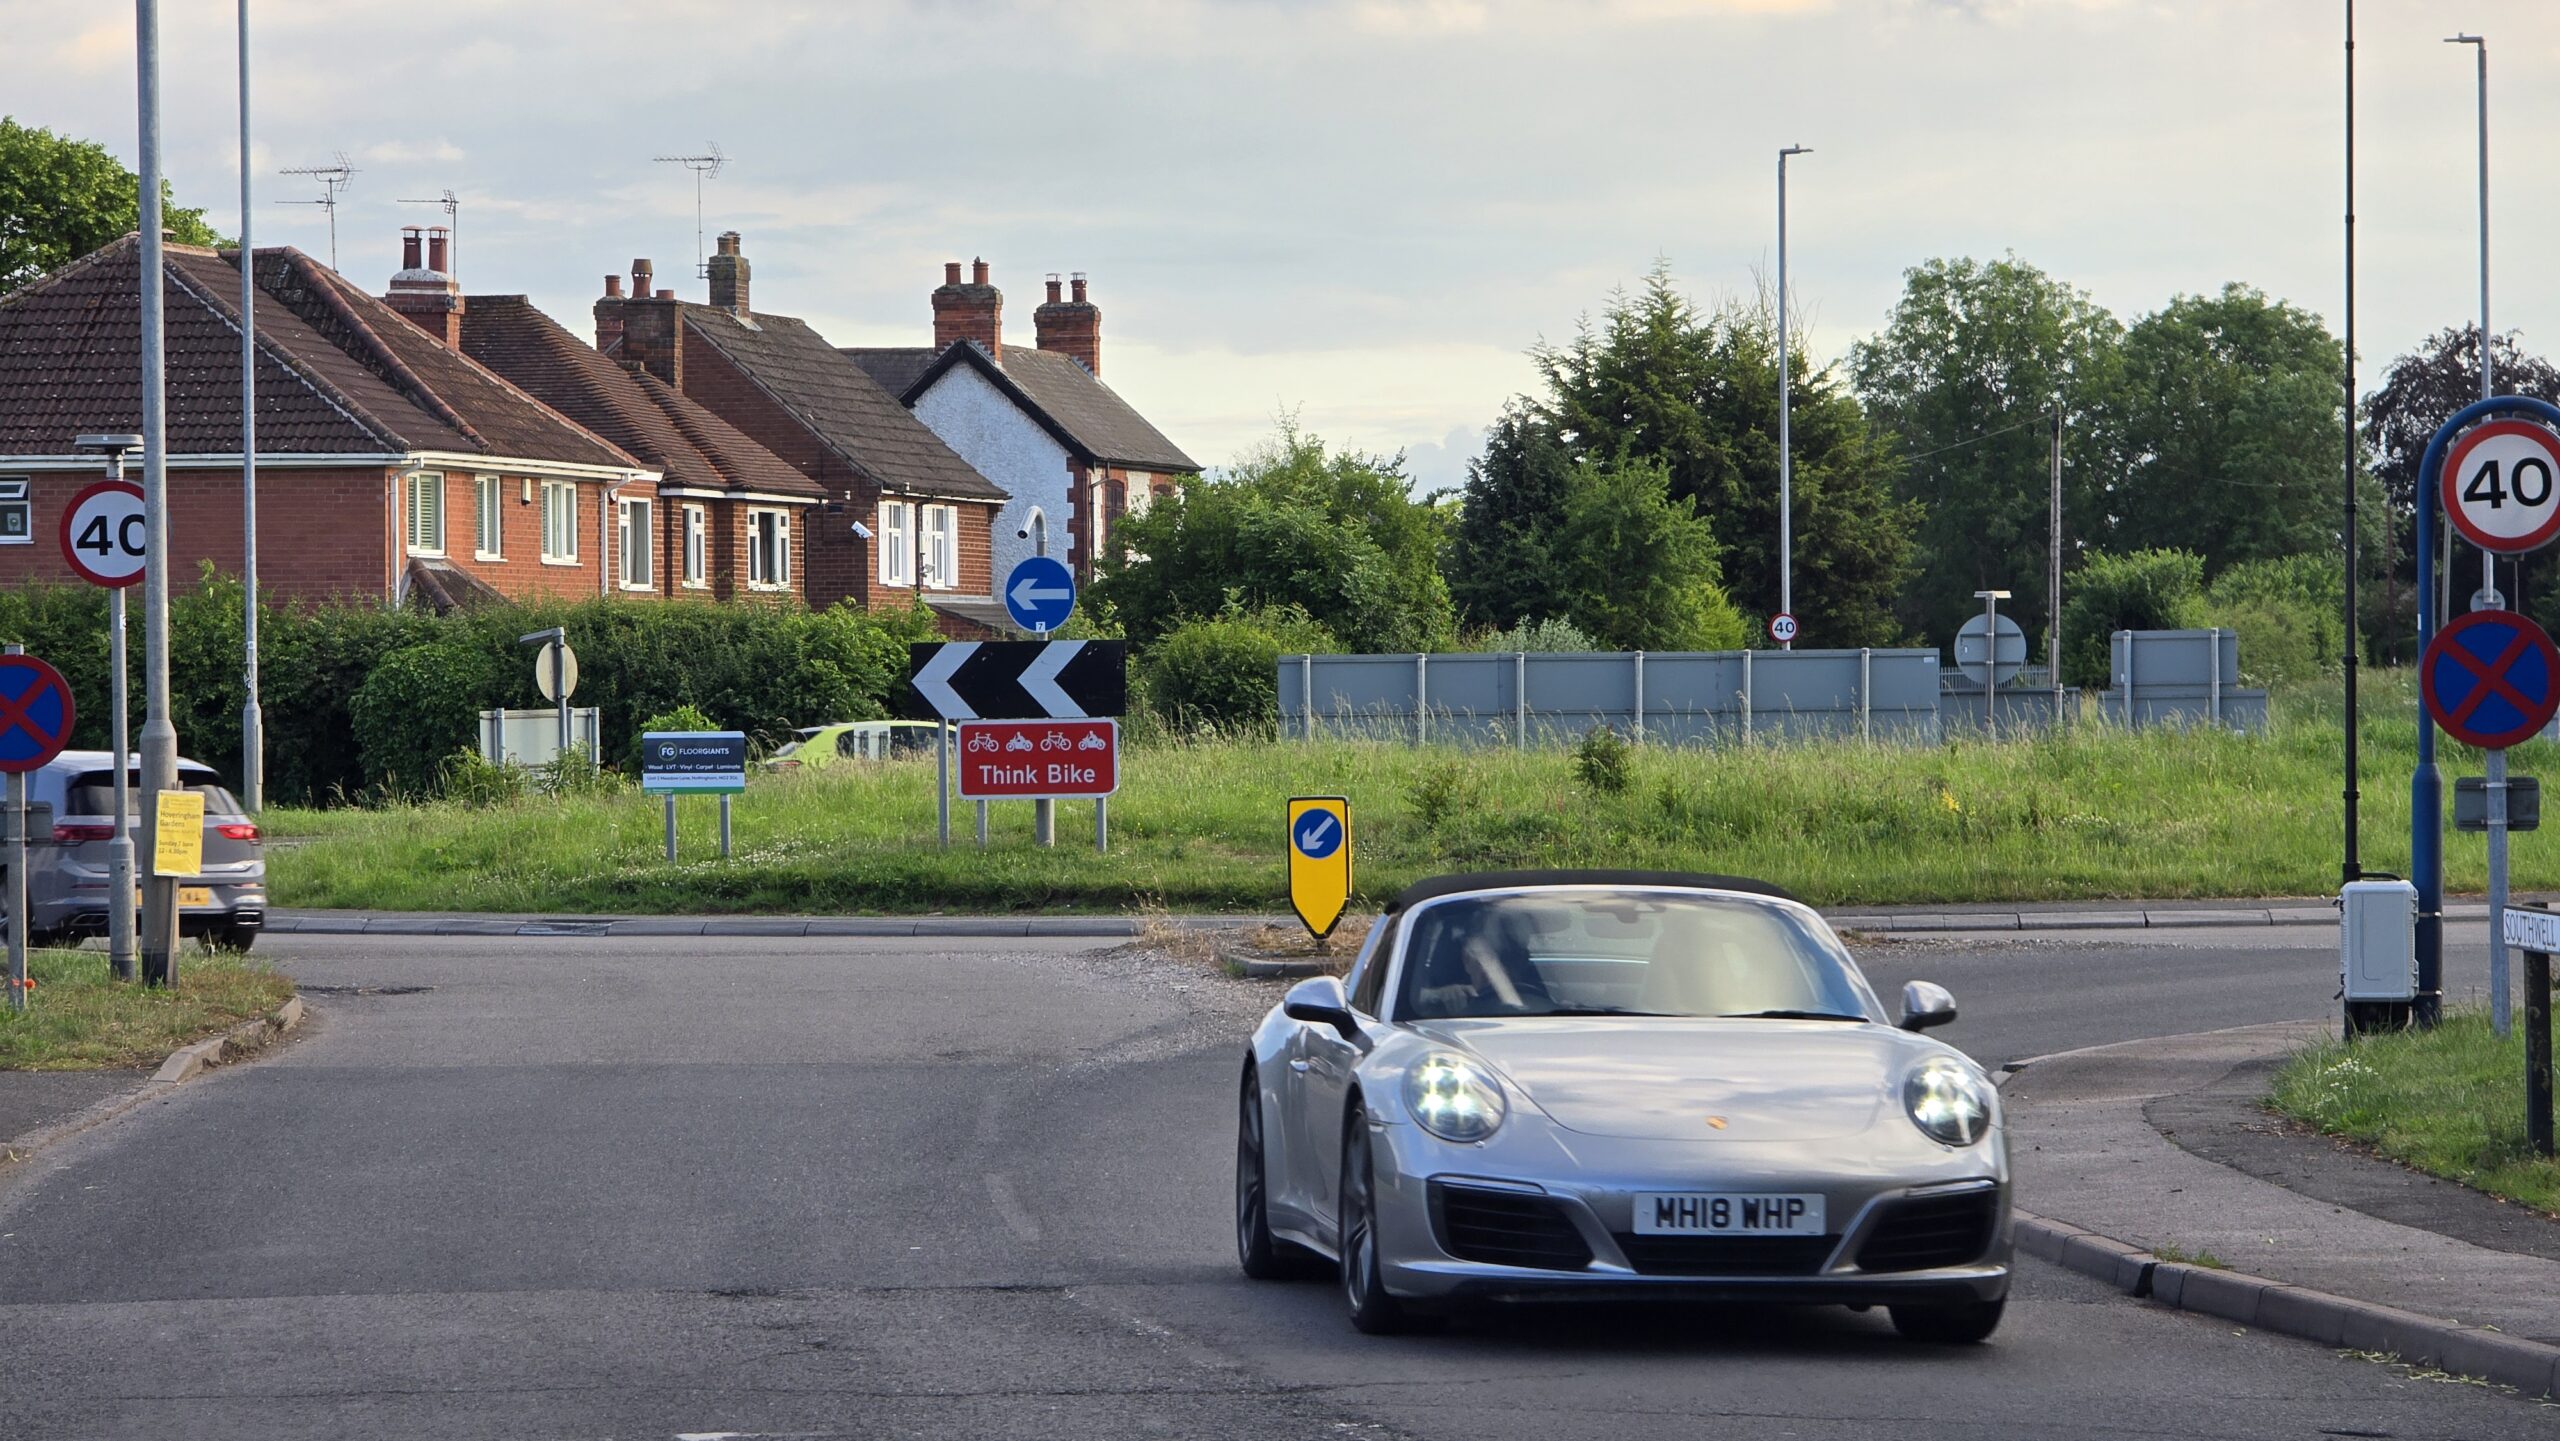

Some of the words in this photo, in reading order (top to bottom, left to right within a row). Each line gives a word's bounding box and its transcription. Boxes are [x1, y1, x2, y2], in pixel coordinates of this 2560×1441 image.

[2463, 457, 2553, 509] 40
[76, 513, 146, 557] 40
[1038, 622, 1043, 630] 7
[1774, 621, 1795, 633] 40
[661, 747, 675, 756] FG
[679, 747, 730, 755] FLOORGIANTS
[695, 763, 714, 771] Carpet
[979, 764, 1038, 785] Think
[1047, 763, 1096, 784] Bike
[160, 810, 201, 820] Hoveringham
[160, 819, 185, 828] Gardens
[158, 839, 178, 848] Sunday
[2505, 913, 2557, 947] SOUTHWELL
[1655, 1197, 1730, 1228] MH18
[1741, 1197, 1806, 1229] WHP
